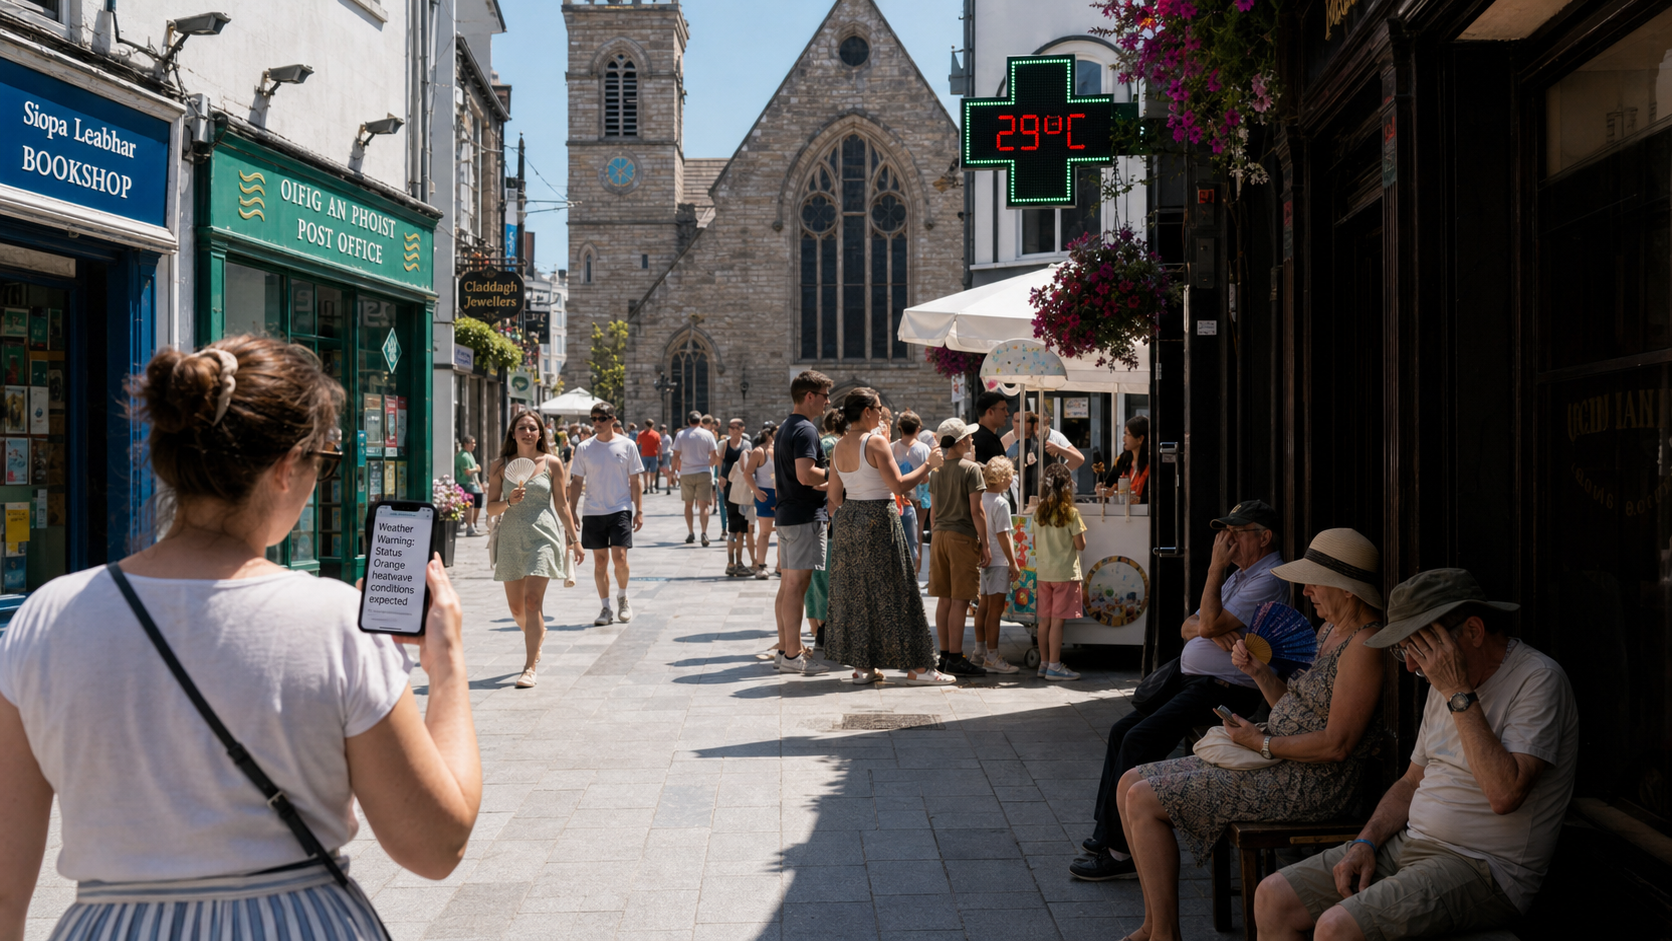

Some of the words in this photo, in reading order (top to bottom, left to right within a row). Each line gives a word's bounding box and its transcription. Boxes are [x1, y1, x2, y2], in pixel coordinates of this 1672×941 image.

[23, 100, 68, 139] Siopa
[73, 117, 136, 158] Leabhar
[21, 145, 132, 199] BOOKSHOP
[281, 178, 322, 212] OIFIG
[326, 196, 346, 221] AN
[350, 205, 396, 239] PHOIST
[297, 218, 334, 249] POST
[337, 232, 383, 265] OFFICE
[463, 280, 518, 296] Claddagh
[463, 296, 517, 310] Jewellers
[378, 522, 414, 533] Weather
[377, 534, 415, 548] Warning:
[375, 546, 403, 557] Status
[373, 558, 406, 571] Orange
[372, 570, 413, 582] heatwave
[370, 583, 415, 595] conditions
[369, 595, 409, 607] expected
